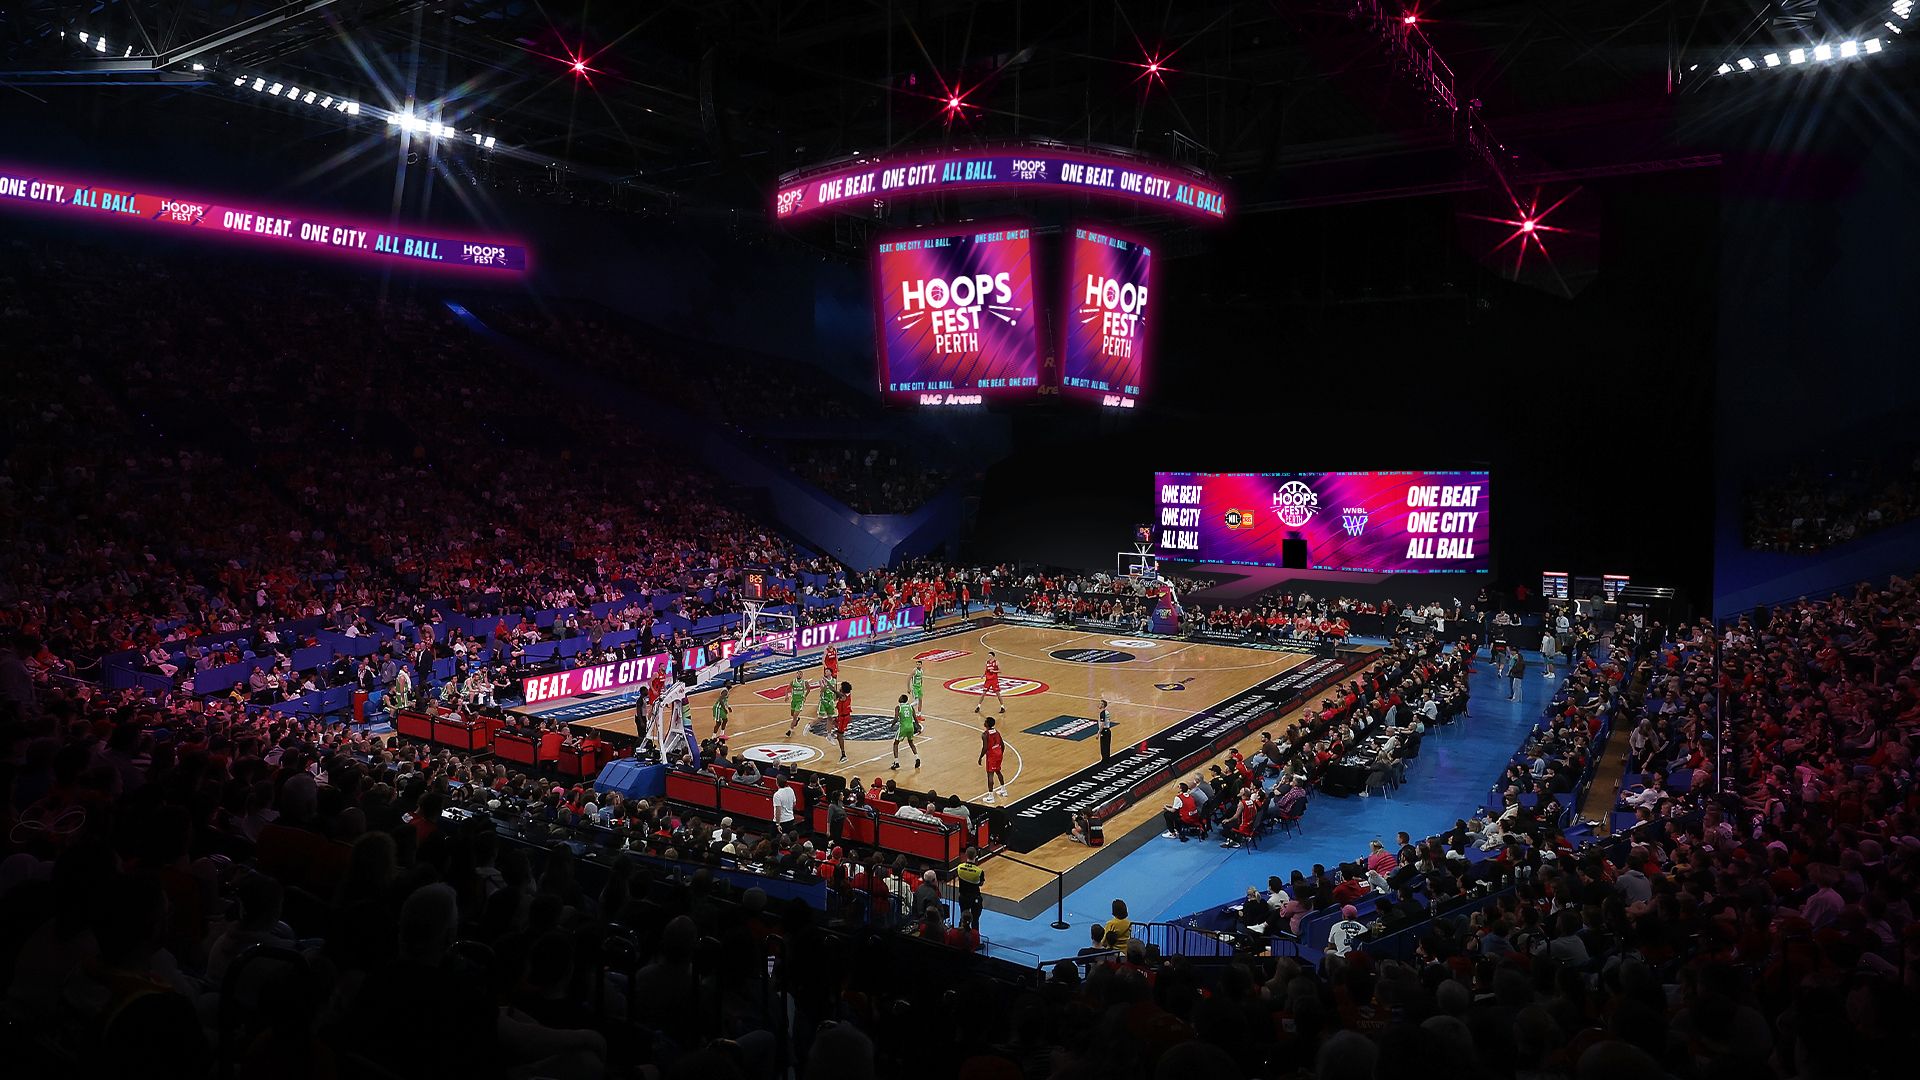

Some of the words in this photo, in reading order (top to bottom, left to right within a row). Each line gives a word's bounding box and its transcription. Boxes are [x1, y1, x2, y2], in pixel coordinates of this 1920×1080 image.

[1013, 160, 1046, 172] HOOPS
[1020, 171, 1036, 180] FEST
[819, 180, 843, 203] ONE
[845, 173, 876, 197] BEAT.
[882, 168, 905, 190] ONE
[908, 164, 936, 186] CITY.
[942, 162, 962, 182] ALL
[965, 161, 997, 180] BALL.
[1061, 163, 1083, 183] ONE
[1085, 166, 1115, 187] BEAT.
[1120, 171, 1141, 193] ONE
[1144, 176, 1171, 199] CITY.
[1176, 184, 1193, 206] ALL
[0, 177, 26, 197] ONE
[30, 182, 65, 203] CITY.
[73, 189, 97, 208] ALL
[102, 193, 140, 214] BALL.
[161, 201, 203, 216] HOOPS
[172, 212, 191, 222] FEST
[223, 211, 251, 231] ONE
[255, 215, 293, 238] BEAT.
[301, 223, 328, 243] ONE
[332, 228, 367, 249] CITY.
[375, 235, 399, 254] ALL
[404, 239, 443, 260] BALL.
[895, 241, 907, 251] ONE
[924, 238, 934, 249] ALL
[975, 234, 987, 243] ONE
[463, 245, 505, 258] HOOPS
[474, 255, 493, 265] FEST
[901, 272, 1012, 310] HOOPS
[1085, 274, 1148, 315] HOOP
[931, 305, 981, 334] FEST
[1103, 312, 1138, 338] FEST
[935, 331, 979, 354] PERTH
[1102, 336, 1132, 359] PERTH
[920, 394, 942, 405] RAC
[945, 394, 982, 405] Arena
[1103, 394, 1121, 407] RAC
[1161, 485, 1179, 504] ONE
[1179, 485, 1203, 504] BEAT
[1273, 493, 1318, 506] HOOPS
[1407, 486, 1440, 507] ONE
[1440, 486, 1481, 507] BEAT
[1161, 508, 1179, 526] ONE
[1180, 508, 1201, 527] CITY
[1284, 506, 1305, 515] FEST
[1285, 515, 1303, 524] PERTH
[1407, 512, 1440, 533] ONE
[1440, 512, 1479, 533] CITY
[1161, 530, 1176, 549] ALL
[1178, 531, 1199, 550] BALL
[1406, 538, 1434, 559] ALL
[1436, 538, 1475, 559] BALL
[750, 575, 762, 583] 8:25
[802, 624, 840, 647] CITY.
[526, 673, 572, 703] BEAT.
[581, 664, 615, 691] ONE
[1017, 781, 1098, 818] WESTERN
[1092, 747, 1165, 782] AUSTRALIA
[1063, 783, 1118, 813] WALKING
[1115, 777, 1134, 788] ON
[1133, 757, 1172, 776] DREAM
